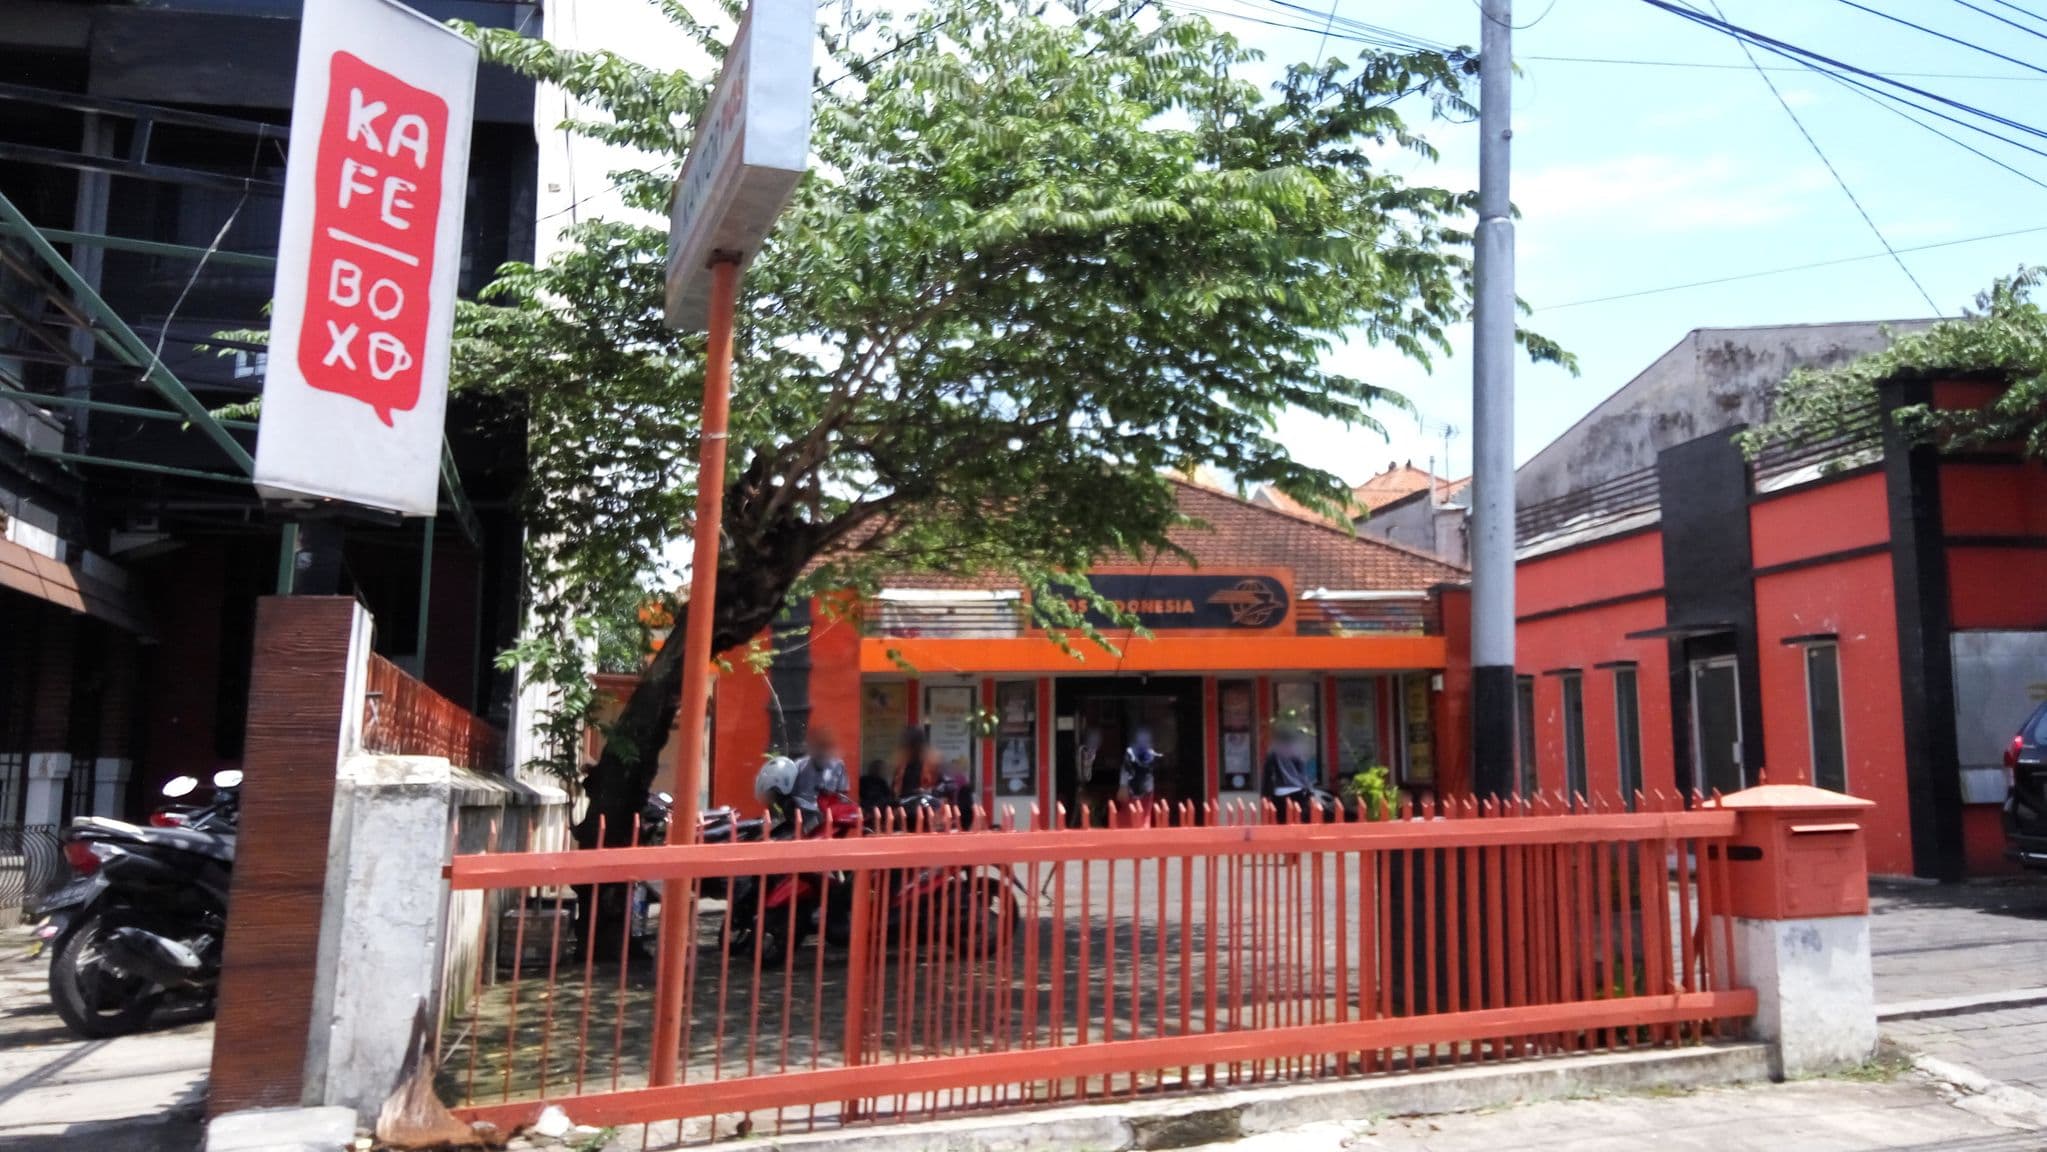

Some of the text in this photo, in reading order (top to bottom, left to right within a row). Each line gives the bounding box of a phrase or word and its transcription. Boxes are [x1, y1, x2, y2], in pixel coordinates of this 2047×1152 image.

[347, 87, 429, 169] KA
[338, 157, 417, 230] FE
[329, 259, 404, 321] BO
[323, 319, 360, 370] X
[1105, 599, 1195, 614] DONESIA
